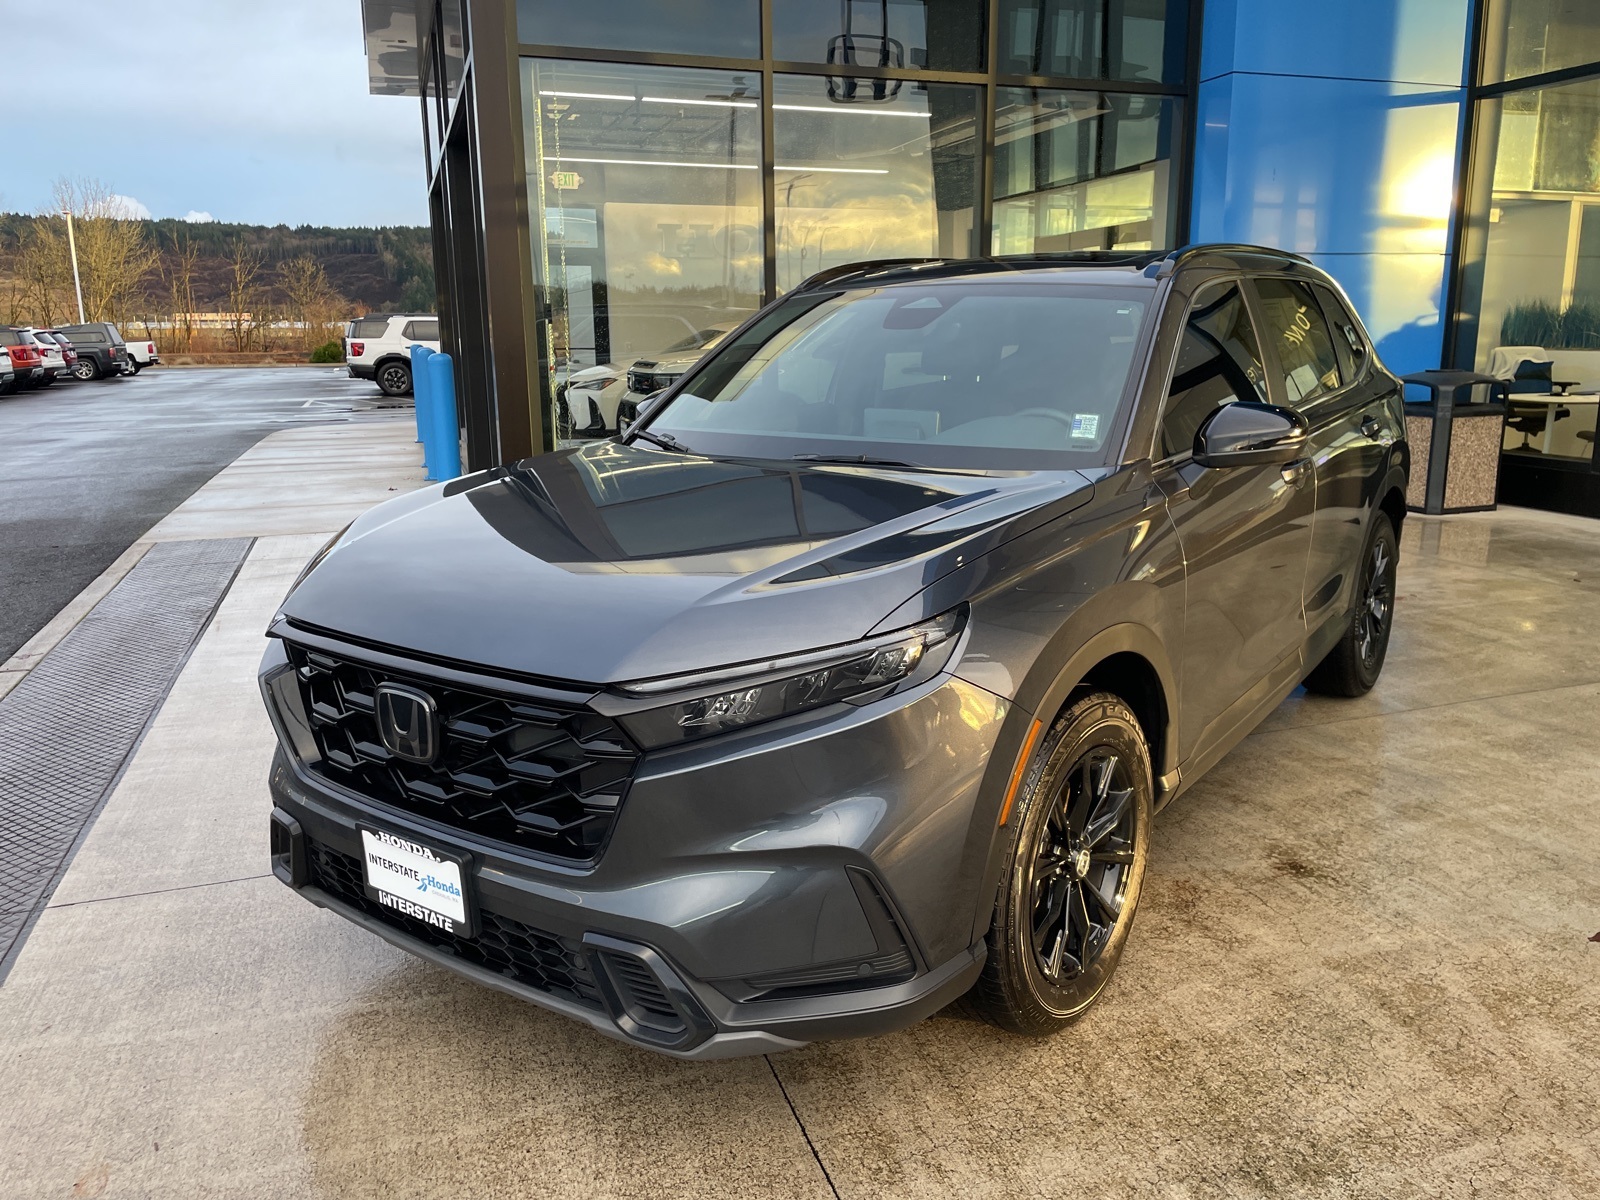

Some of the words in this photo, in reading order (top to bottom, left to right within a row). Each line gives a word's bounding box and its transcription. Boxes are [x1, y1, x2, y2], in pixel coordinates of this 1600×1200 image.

[557, 173, 575, 187] EXIT
[378, 831, 436, 860] HONDA
[368, 852, 420, 882] INTERSTATE
[426, 874, 461, 897] Honda
[378, 890, 454, 933] INTERSTATE
